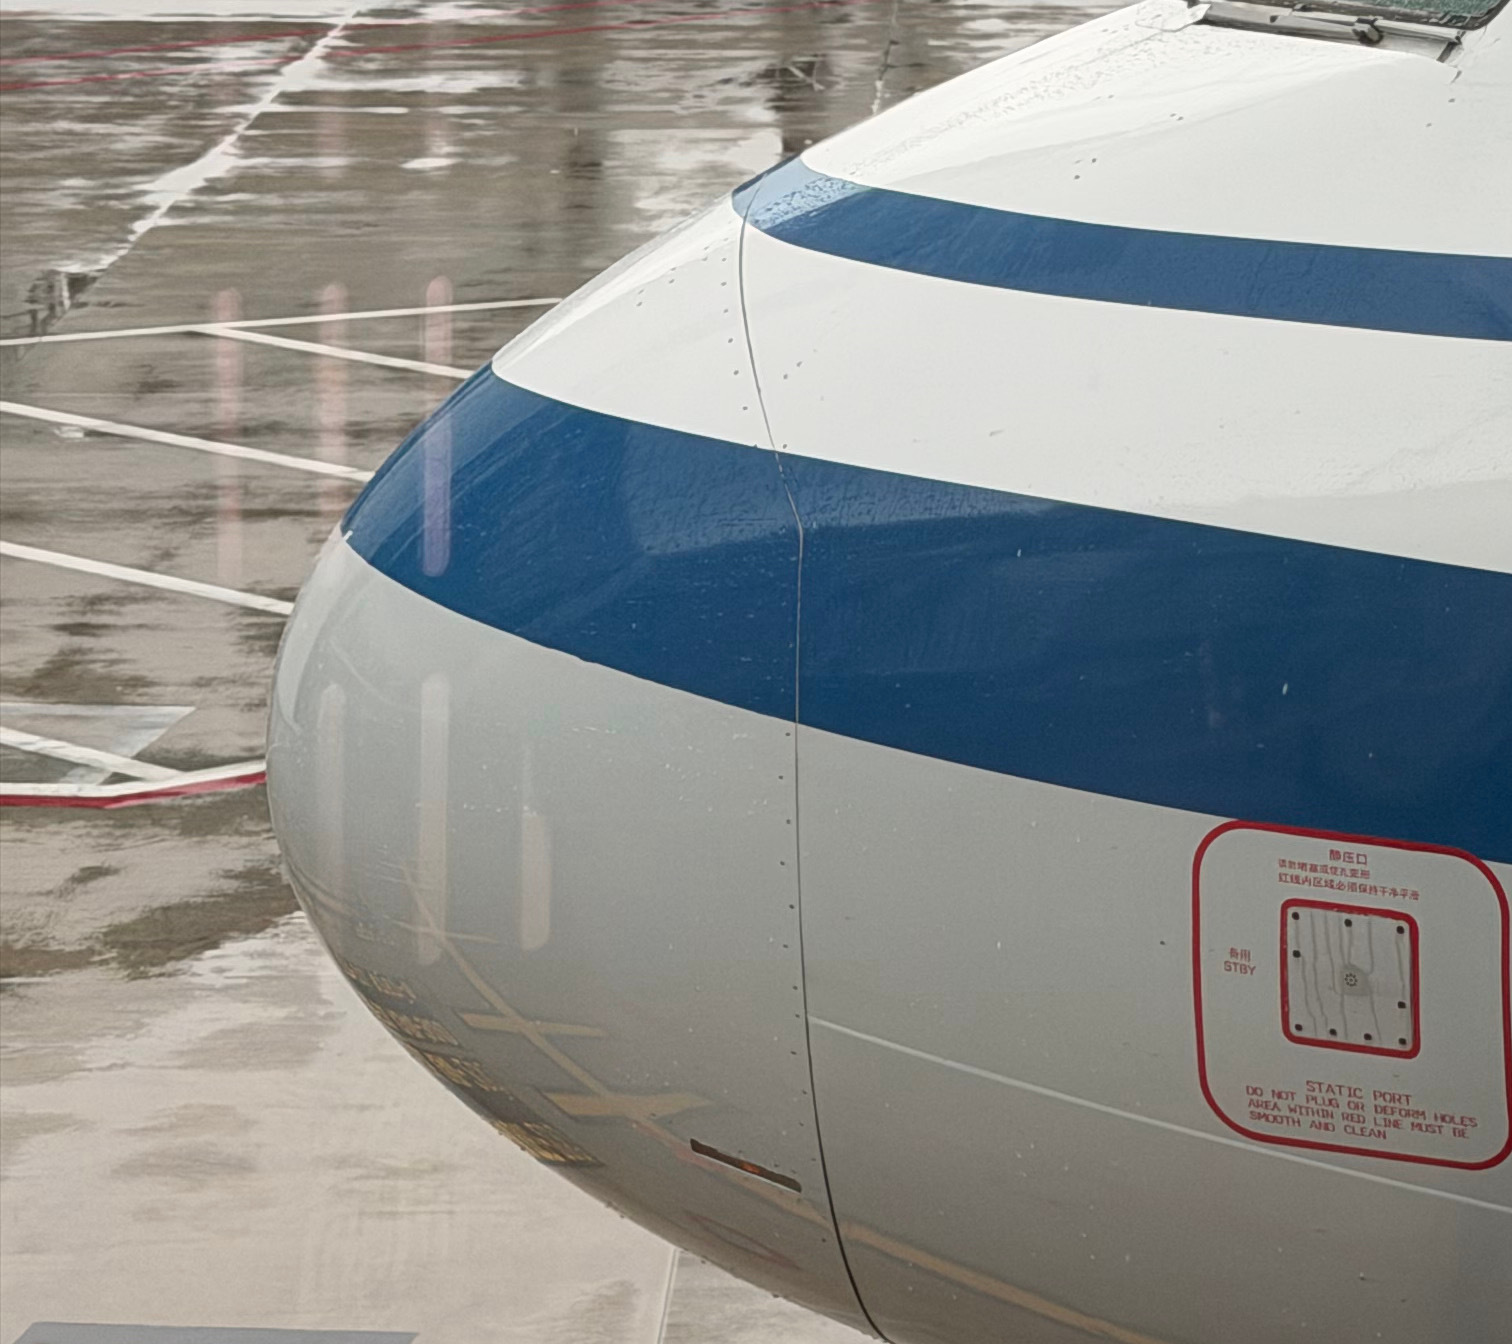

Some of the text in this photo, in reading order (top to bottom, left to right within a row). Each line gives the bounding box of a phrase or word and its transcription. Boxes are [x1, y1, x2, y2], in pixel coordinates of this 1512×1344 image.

[1329, 848, 1367, 865] 静压口
[1223, 960, 1257, 976] STBY
[1246, 1085, 1478, 1128] DO NOT PLUG OR DEFORM HOLES
[1305, 1080, 1412, 1106] STATIC PORT
[1248, 1098, 1470, 1139] AREA WITHIN RED LINE MUST BE
[1249, 1110, 1387, 1140] SMOOTH AND CLEAN
